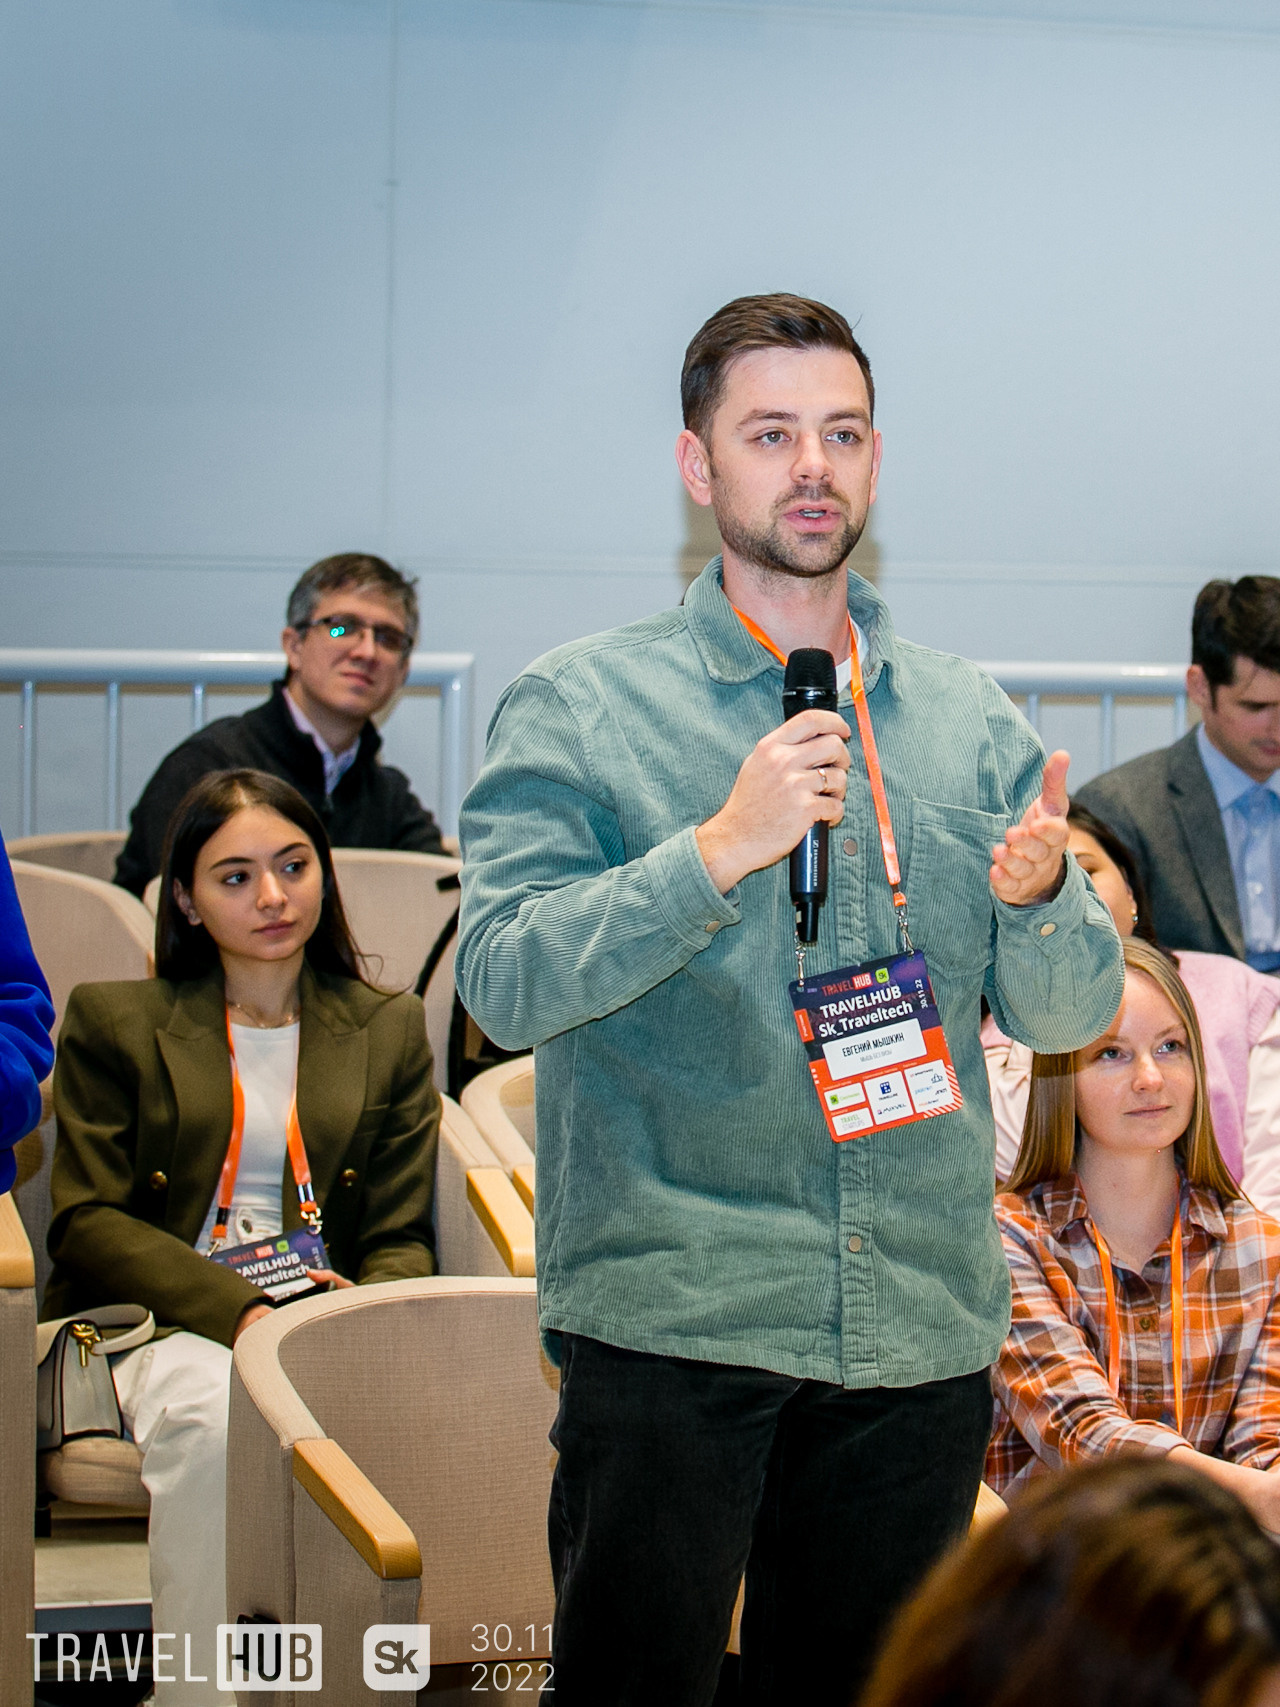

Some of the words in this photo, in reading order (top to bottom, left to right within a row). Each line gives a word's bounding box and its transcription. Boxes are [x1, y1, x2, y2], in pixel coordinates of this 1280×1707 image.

[822, 981, 854, 997] TRAVEL
[854, 973, 872, 988] HUB
[914, 979, 928, 1009] 30.11.22
[820, 985, 902, 1019] TRAVELHUB
[818, 1000, 914, 1038] Sk_Traveltech
[842, 1039, 872, 1057] ЕВГЕНИЙ
[872, 1032, 904, 1049] МЫШКИН
